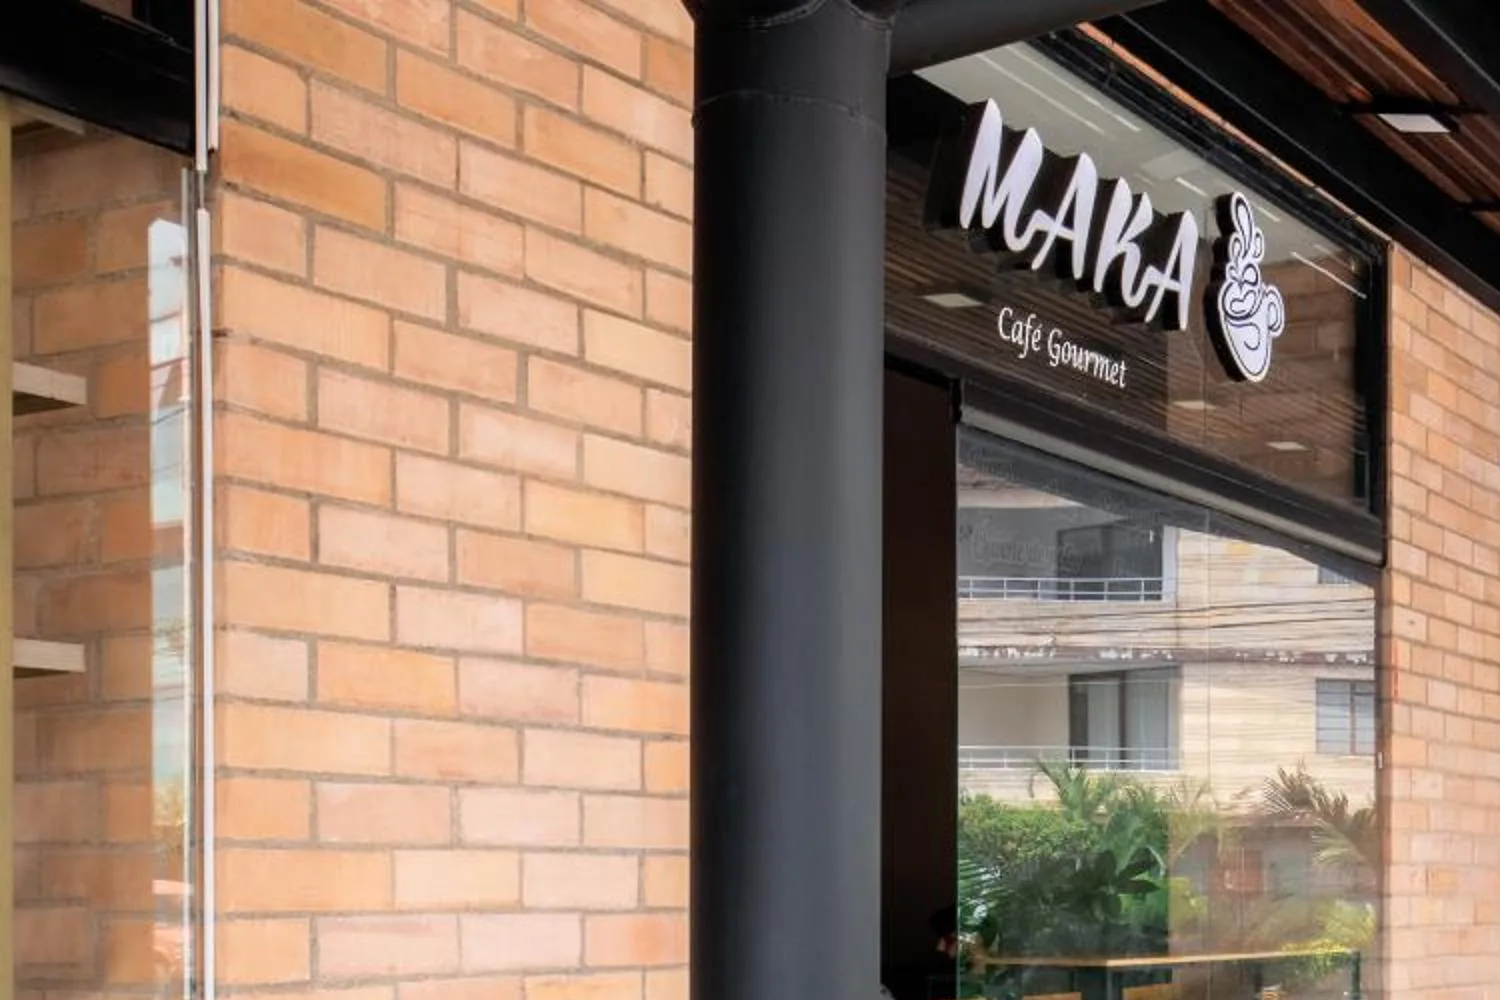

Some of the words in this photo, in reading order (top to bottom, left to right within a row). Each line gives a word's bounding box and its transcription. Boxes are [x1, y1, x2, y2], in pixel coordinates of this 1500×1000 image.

[959, 97, 1200, 331] MAKA
[997, 306, 1043, 359] Café
[1047, 327, 1128, 389] Gourmet
